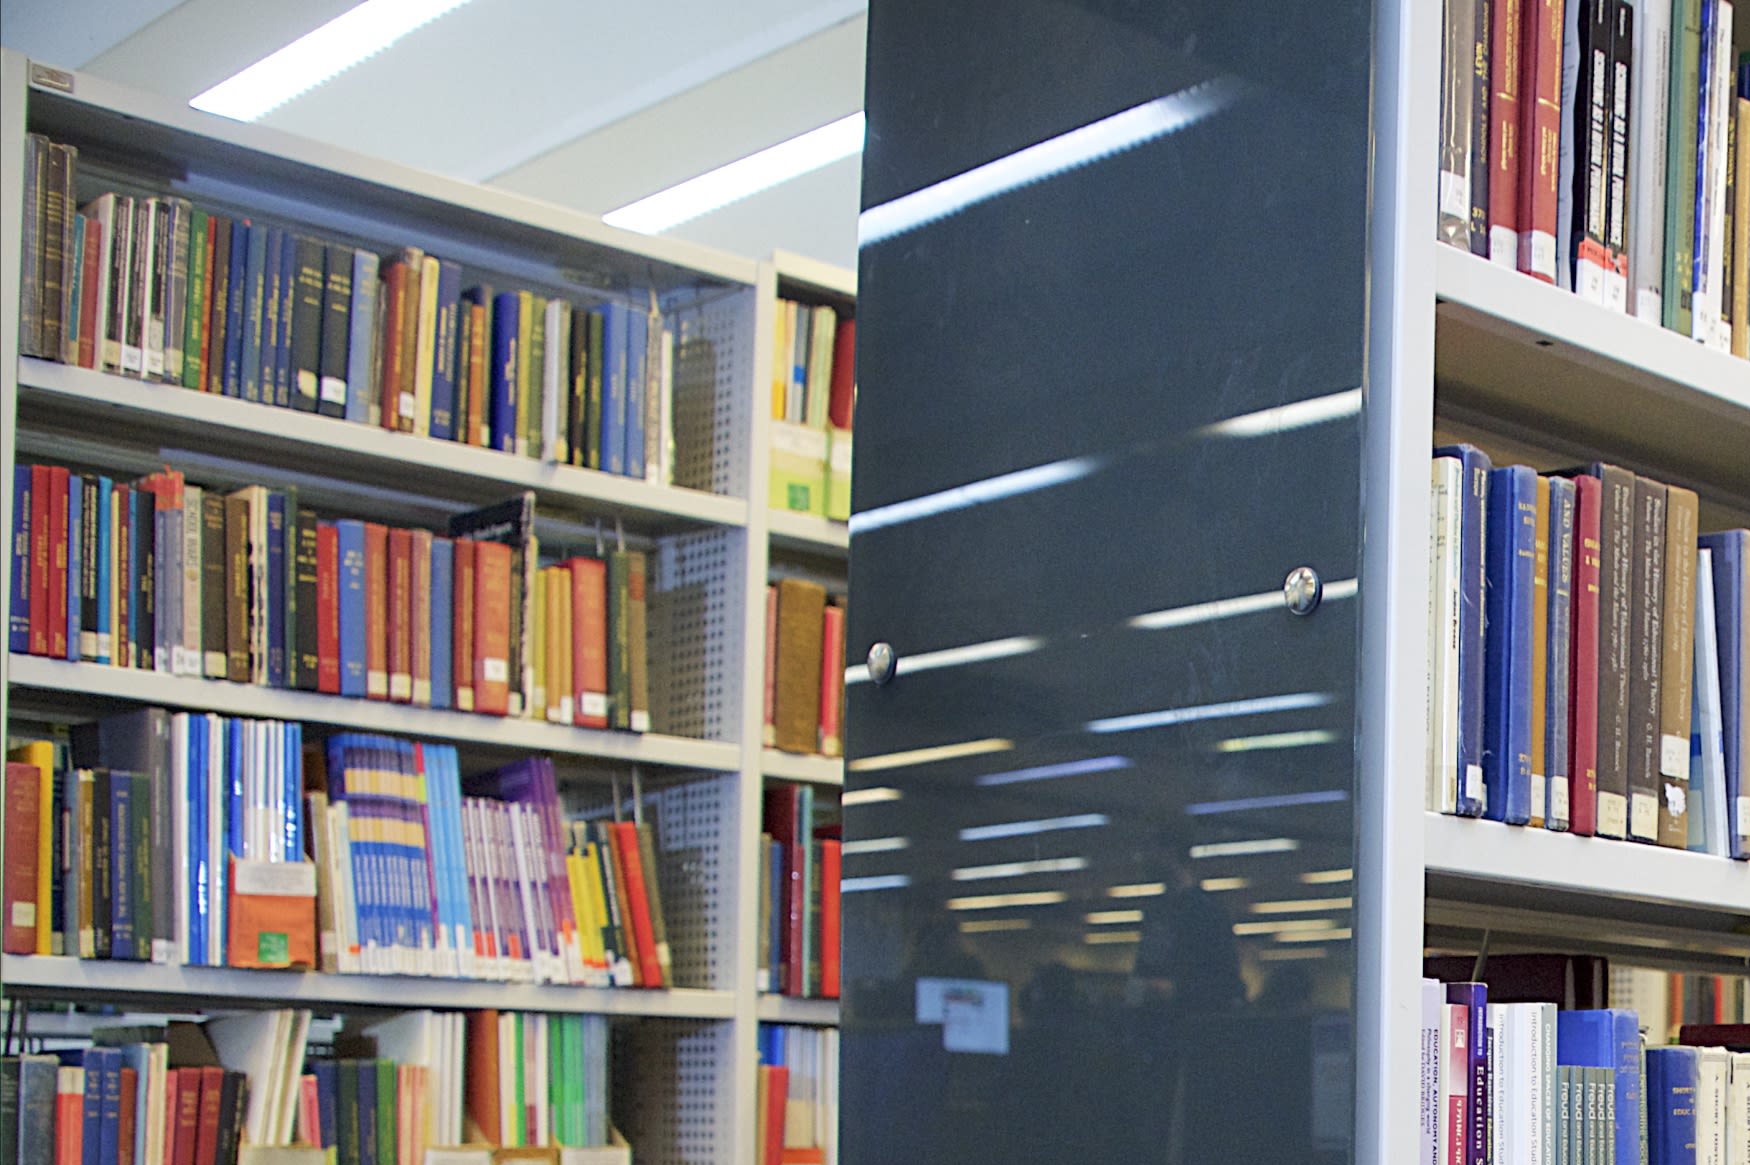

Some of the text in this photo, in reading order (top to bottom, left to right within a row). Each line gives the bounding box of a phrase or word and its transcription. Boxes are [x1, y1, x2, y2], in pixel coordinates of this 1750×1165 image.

[1562, 498, 1571, 584] AND VALUES
[1622, 525, 1628, 535] in
[1654, 536, 1660, 547] in
[1652, 568, 1660, 602] History
[1620, 598, 1627, 609] of
[1652, 607, 1659, 619] of
[1619, 611, 1627, 668] Educational
[1651, 620, 1659, 677] Educational
[1618, 672, 1627, 708] Theory
[1649, 681, 1657, 717] Theory
[1530, 1012, 1538, 1073] Introduction
[1498, 1076, 1504, 1087] to
[1531, 1075, 1538, 1086] to
[1476, 1065, 1484, 1149] Education
[1530, 1088, 1538, 1137] Education
[1545, 1108, 1552, 1121] OF
[1561, 1082, 1569, 1119] Freud
[1575, 1083, 1583, 1120] Freud
